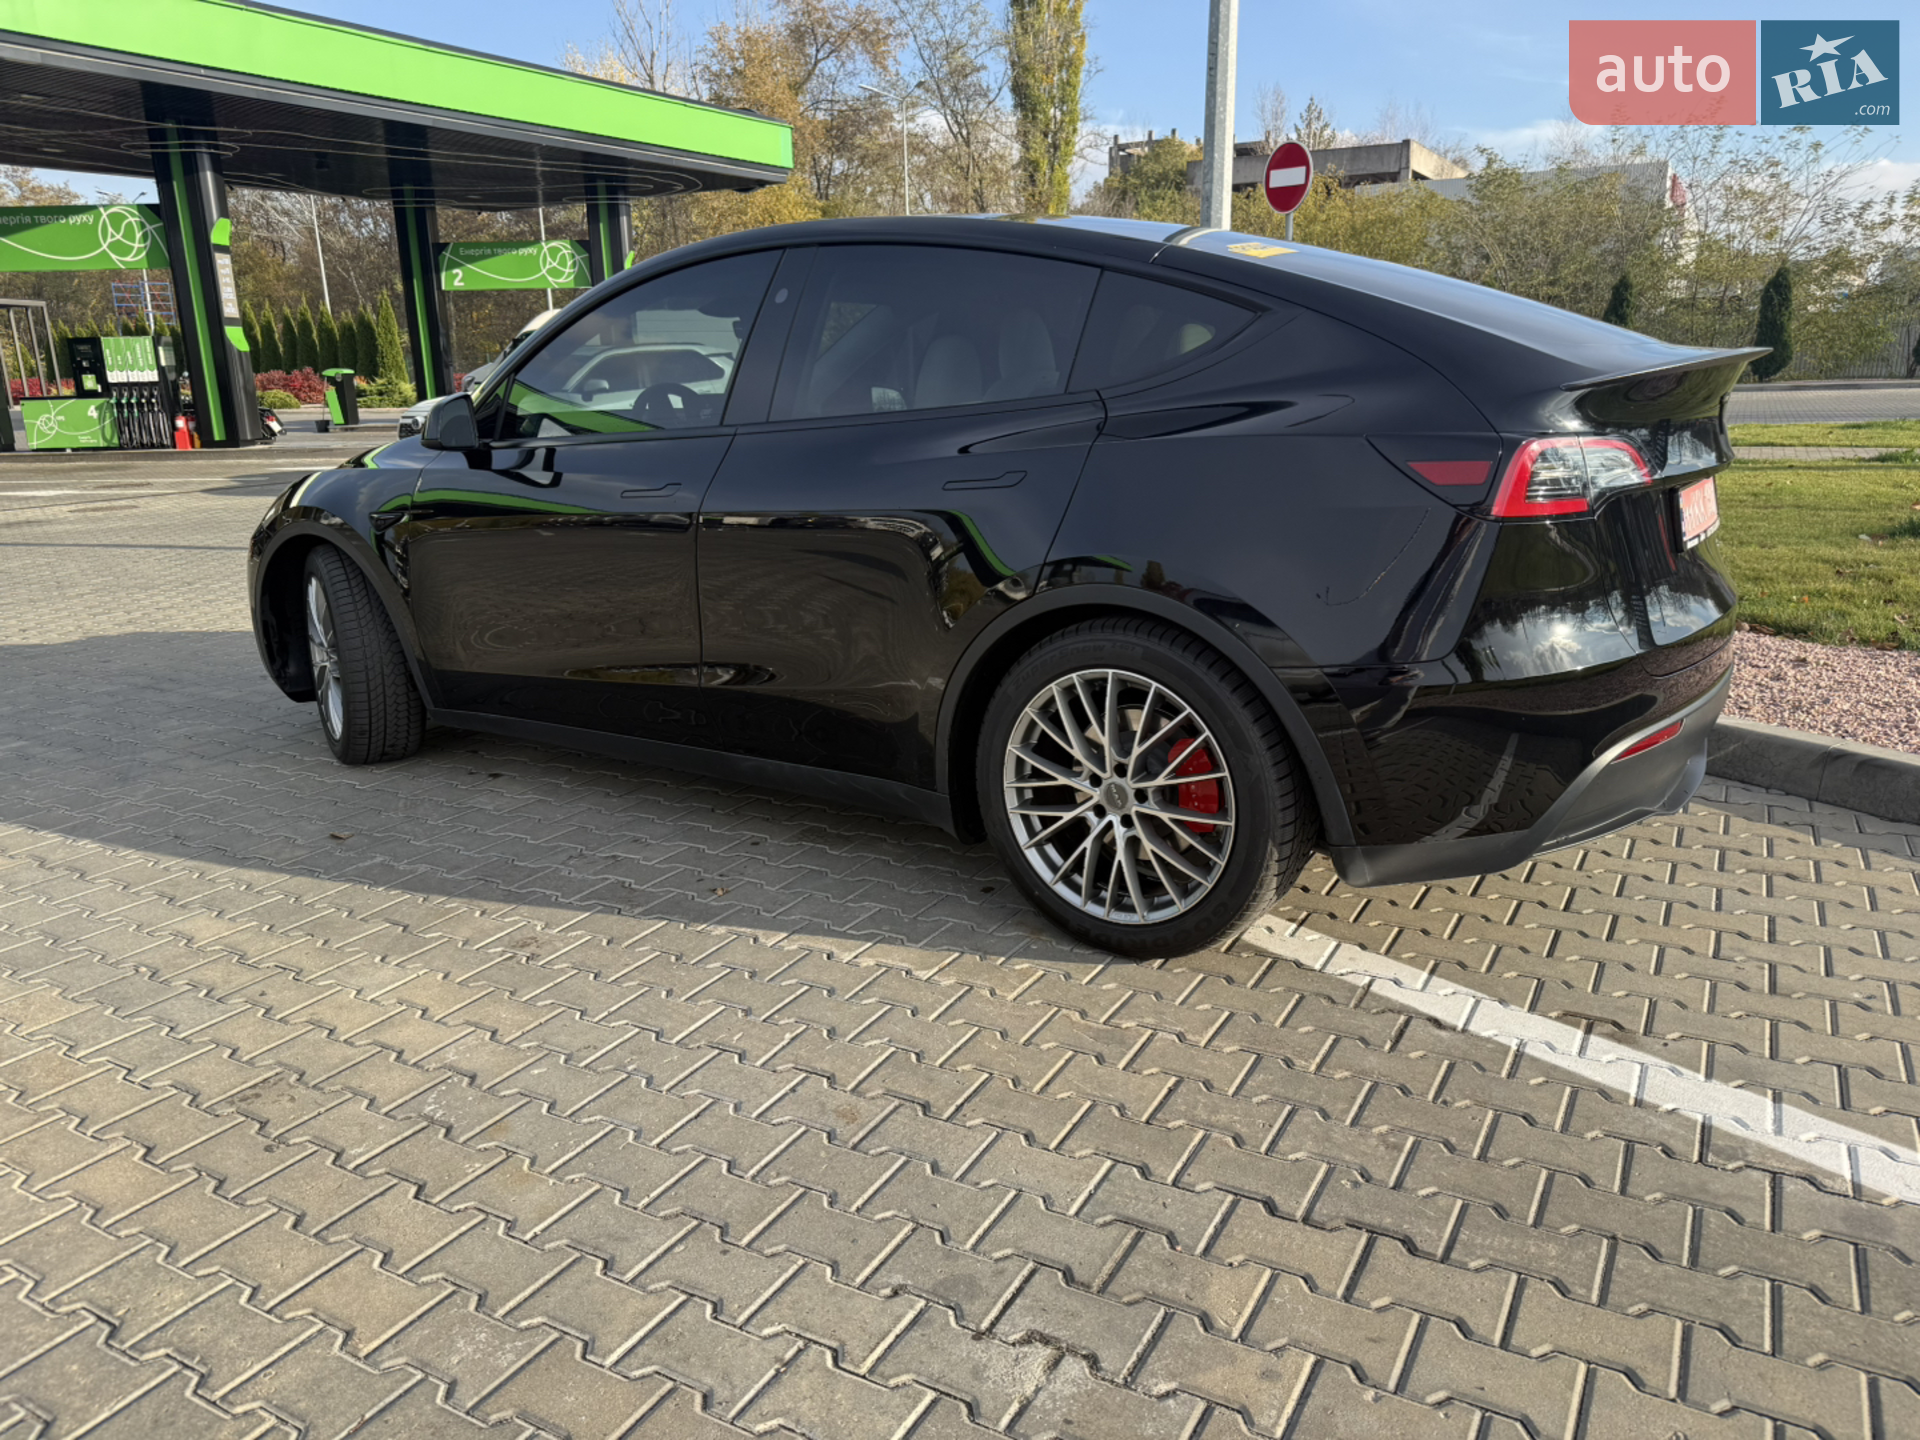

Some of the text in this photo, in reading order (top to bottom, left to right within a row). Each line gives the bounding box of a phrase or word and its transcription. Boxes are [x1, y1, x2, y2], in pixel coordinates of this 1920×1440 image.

[33, 215, 67, 224] твого
[69, 215, 94, 226] руху
[518, 247, 538, 256] руху
[452, 268, 465, 286] 2
[87, 405, 99, 419] 4
